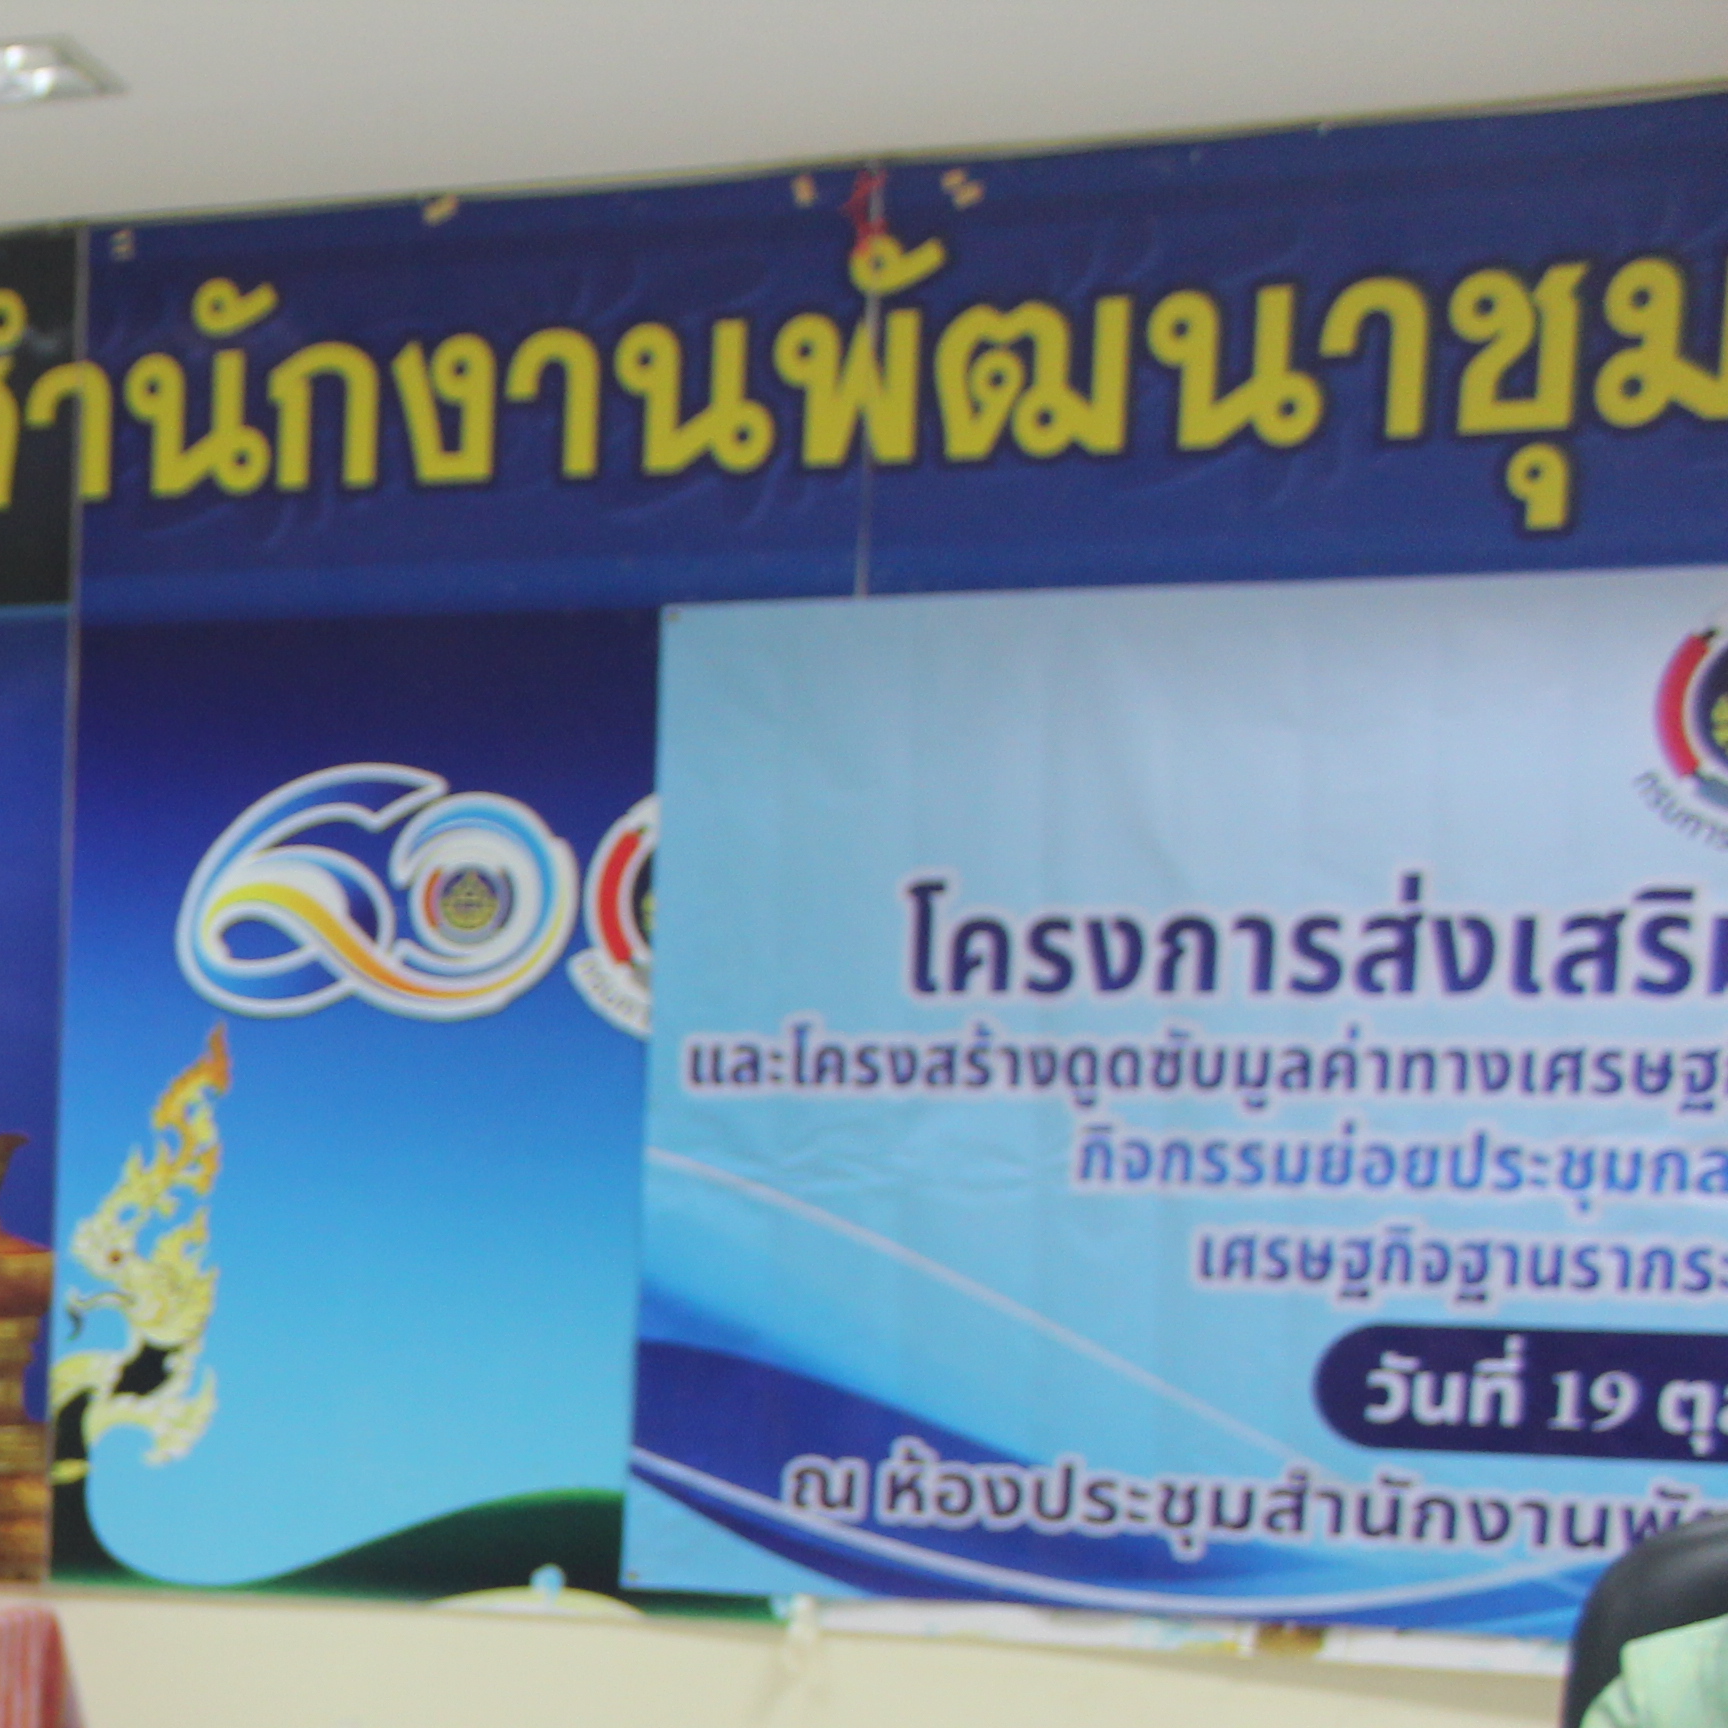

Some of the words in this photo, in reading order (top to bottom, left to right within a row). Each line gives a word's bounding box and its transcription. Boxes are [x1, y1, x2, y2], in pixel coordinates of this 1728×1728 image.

[908, 872, 1728, 994] โครงการส่งเสริ
[1362, 1333, 1526, 1429] วันที่
[1547, 1369, 1642, 1433] 19
[1657, 1377, 1728, 1457] ตุ
[793, 1466, 855, 1512] ณ
[885, 1446, 1728, 1550] ห้องประชุมสำนักงานพั
